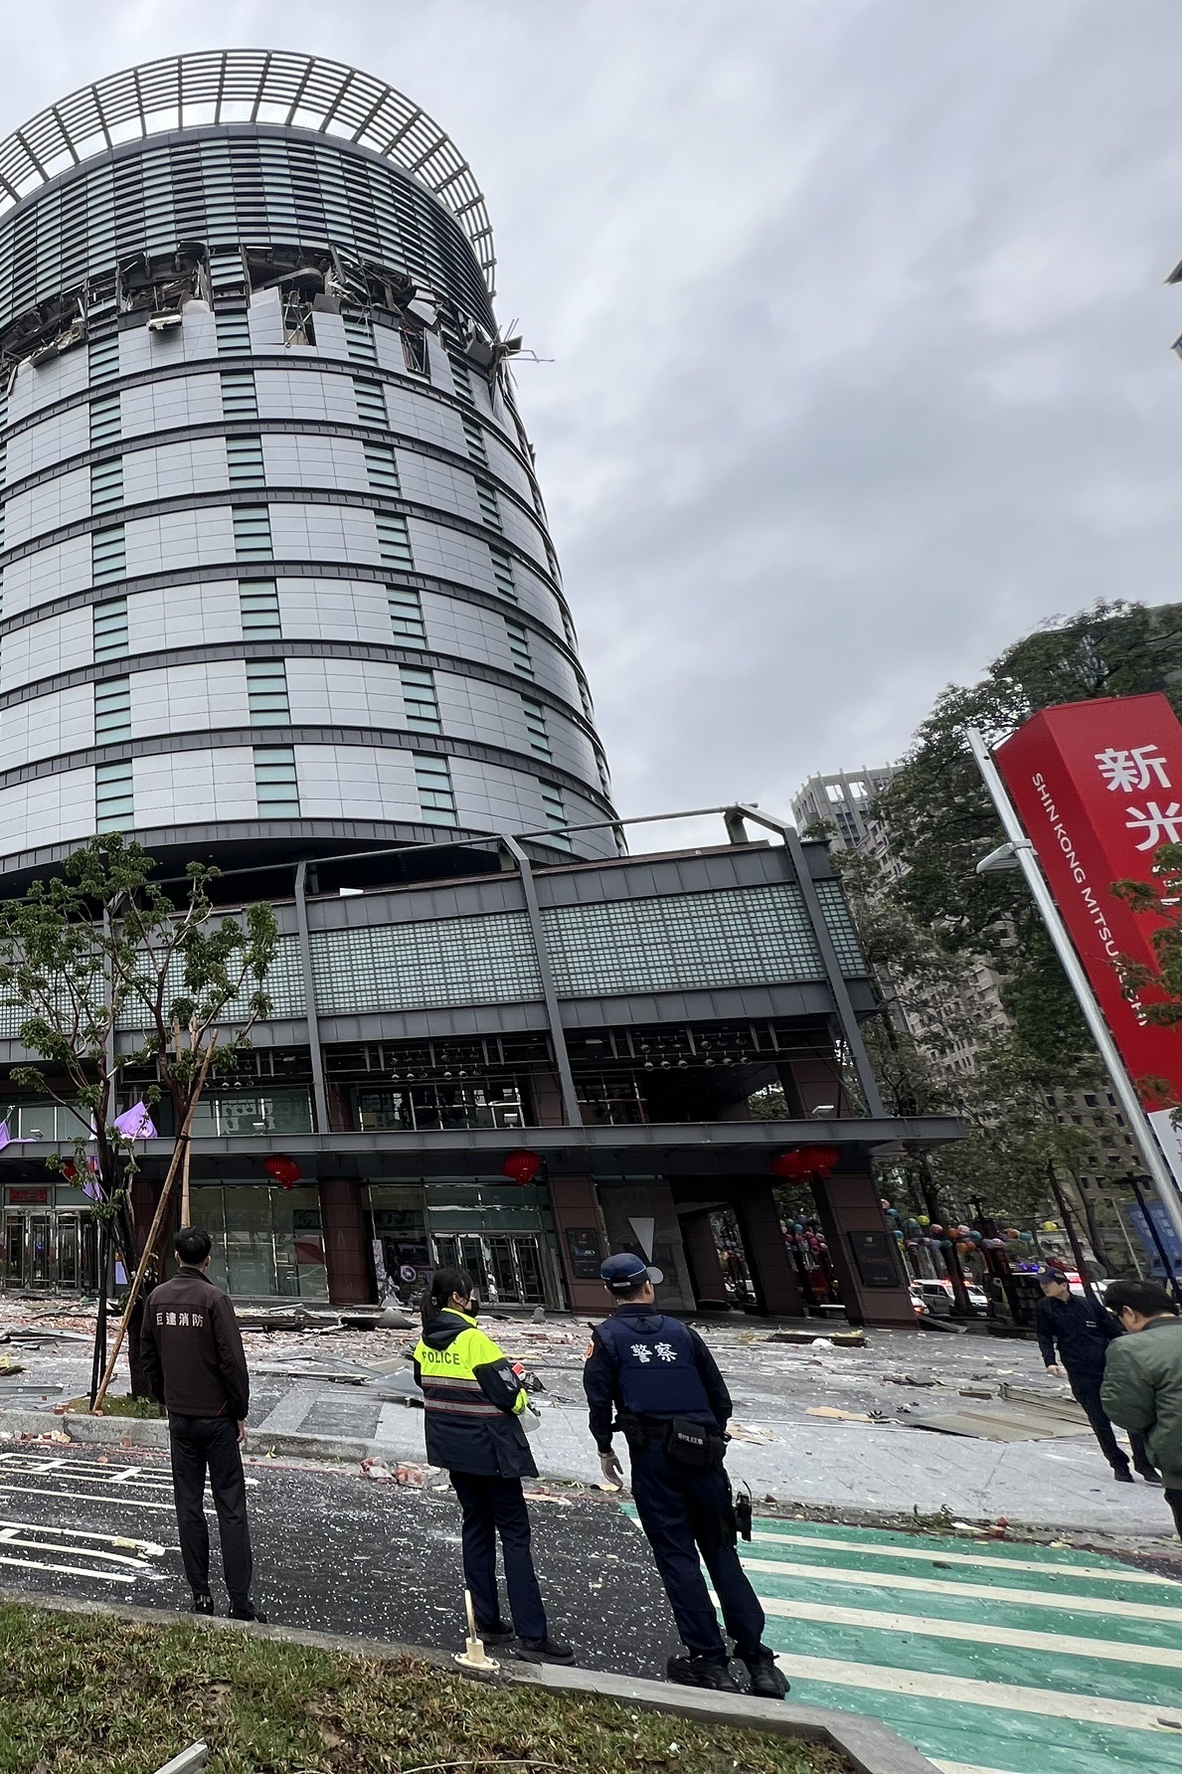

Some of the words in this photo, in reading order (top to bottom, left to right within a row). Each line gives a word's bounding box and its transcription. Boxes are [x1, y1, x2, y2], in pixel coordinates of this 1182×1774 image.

[1032, 772, 1060, 823] SHIN
[1053, 822, 1086, 885] KONG
[421, 1351, 461, 1366] POLICE
[630, 1342, 678, 1364] 警察
